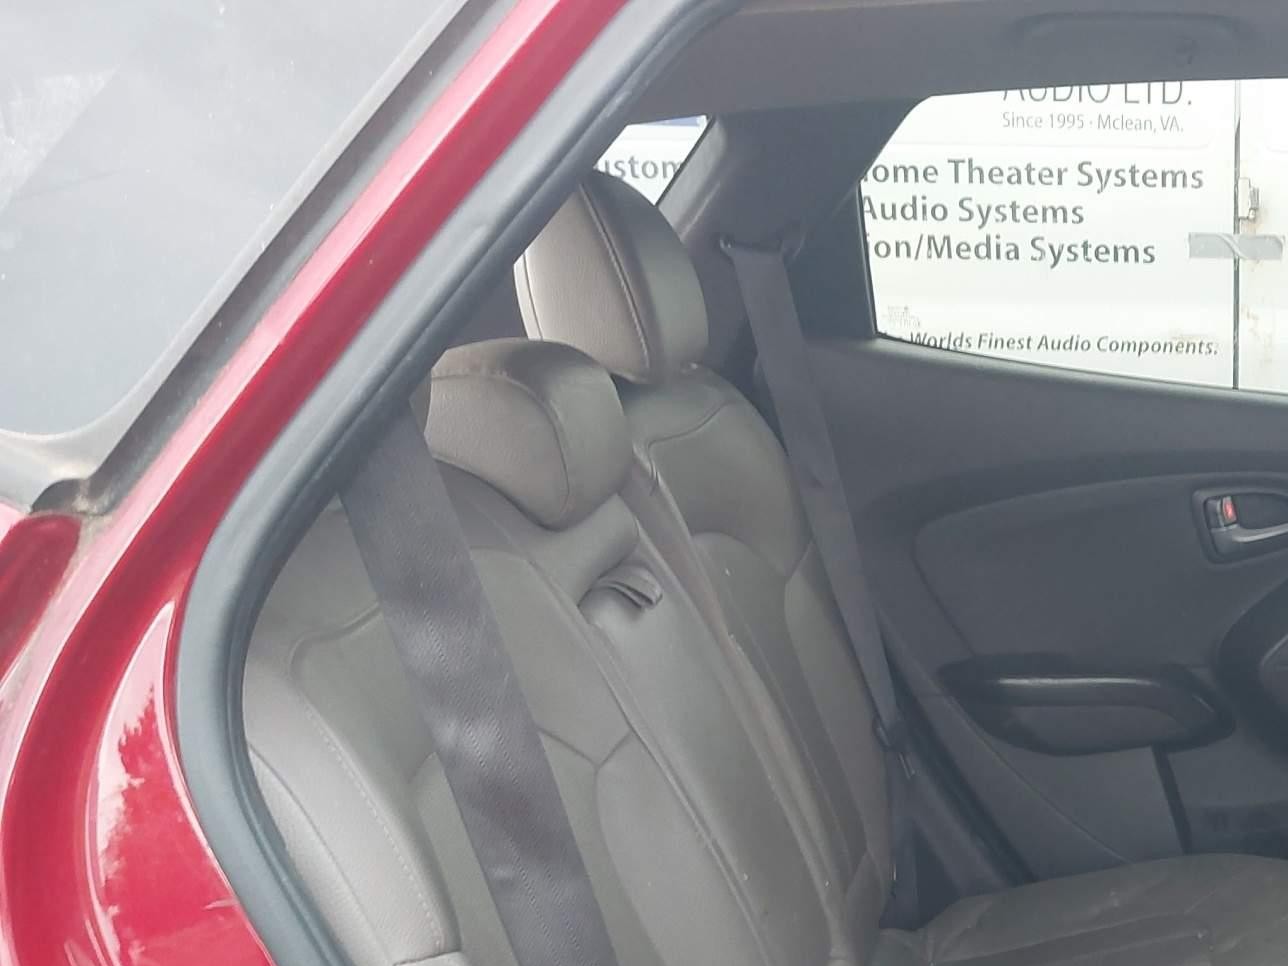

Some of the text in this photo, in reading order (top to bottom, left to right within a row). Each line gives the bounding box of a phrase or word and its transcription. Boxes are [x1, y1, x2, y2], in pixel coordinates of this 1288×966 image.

[1002, 111, 1043, 128] Since
[1049, 113, 1084, 129] 1995
[1097, 114, 1156, 133] Mclean,
[1160, 115, 1184, 132] VA.
[864, 158, 1204, 194] ome Theater Systems
[863, 195, 1084, 230] Audio Systems
[1030, 235, 1156, 269] Systems
[977, 331, 1032, 351] Finest
[1037, 334, 1091, 352] Audio
[1097, 335, 1218, 357] Components.
